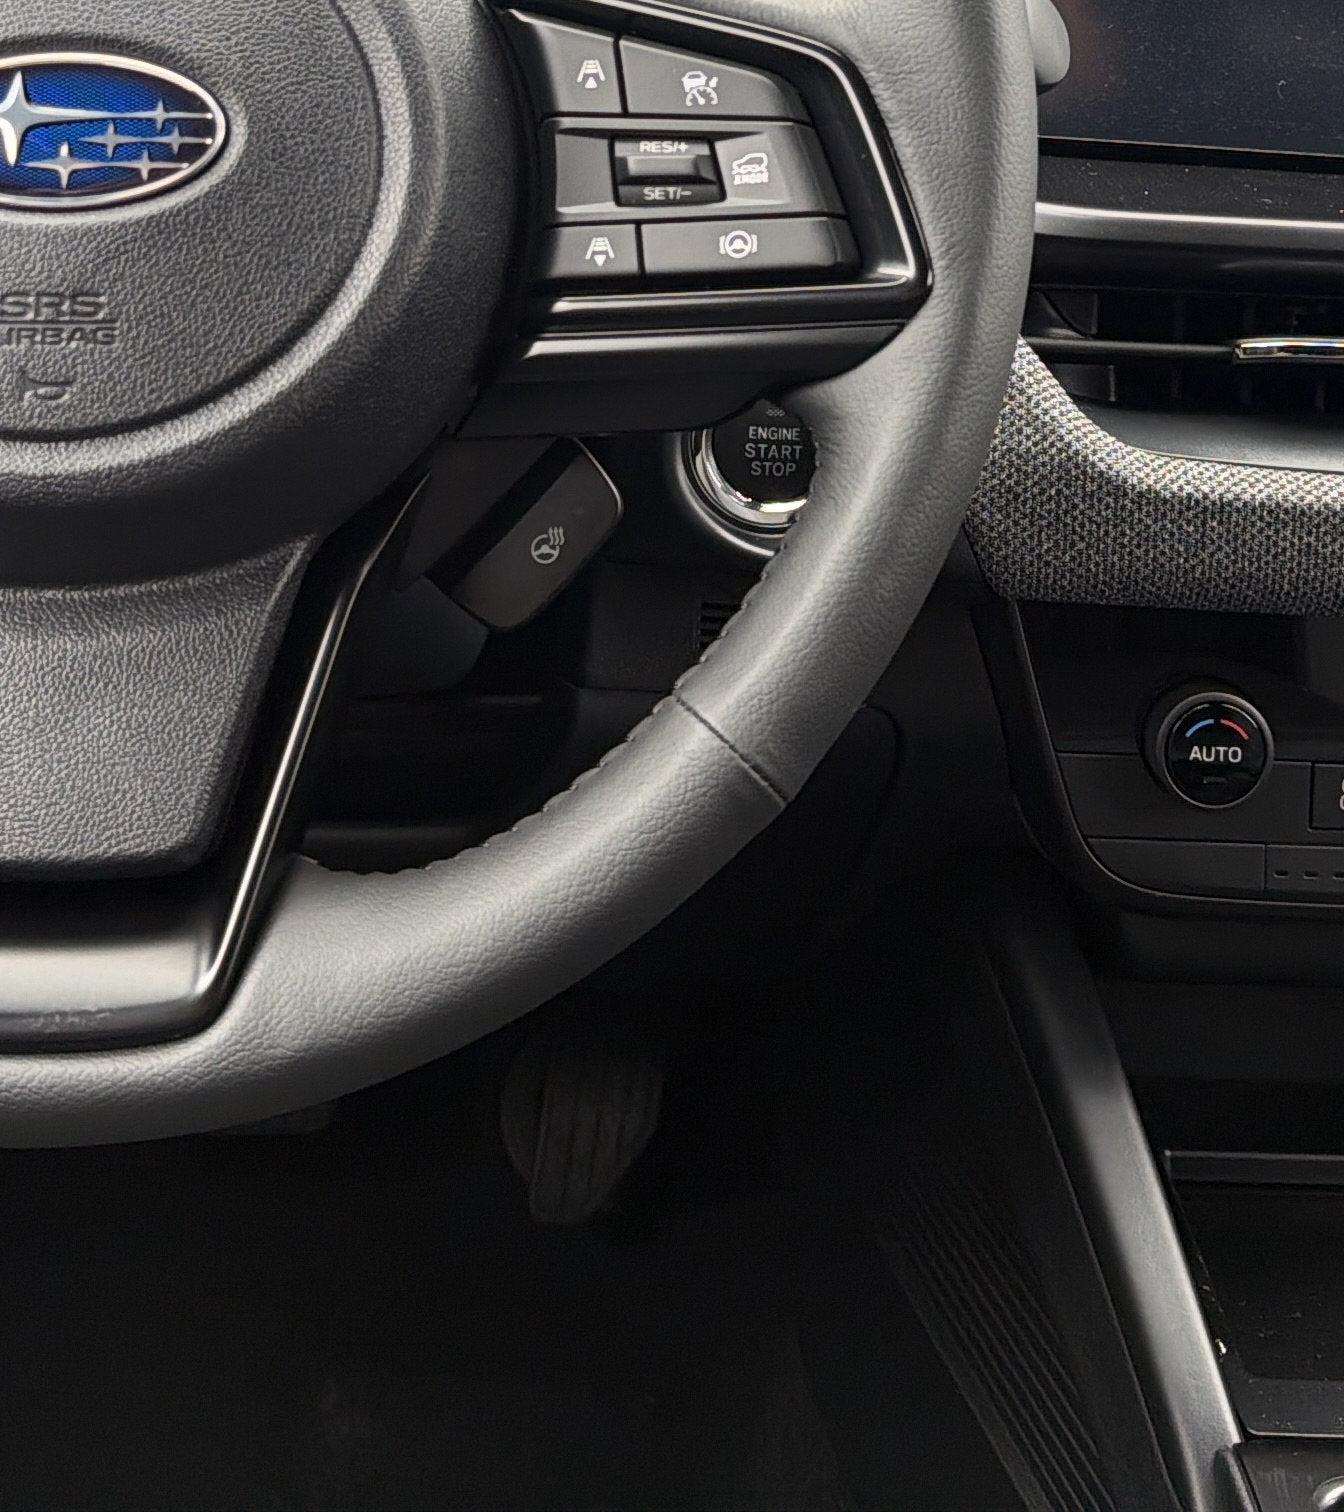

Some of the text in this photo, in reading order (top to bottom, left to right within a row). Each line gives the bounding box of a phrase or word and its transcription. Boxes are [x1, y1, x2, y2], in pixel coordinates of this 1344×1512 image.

[639, 141, 689, 153] RES/+
[0, 292, 106, 320] SRS
[748, 426, 800, 441] ENGINE
[744, 443, 803, 460] START
[751, 461, 796, 477] STOP
[1189, 745, 1242, 764] AUTO
